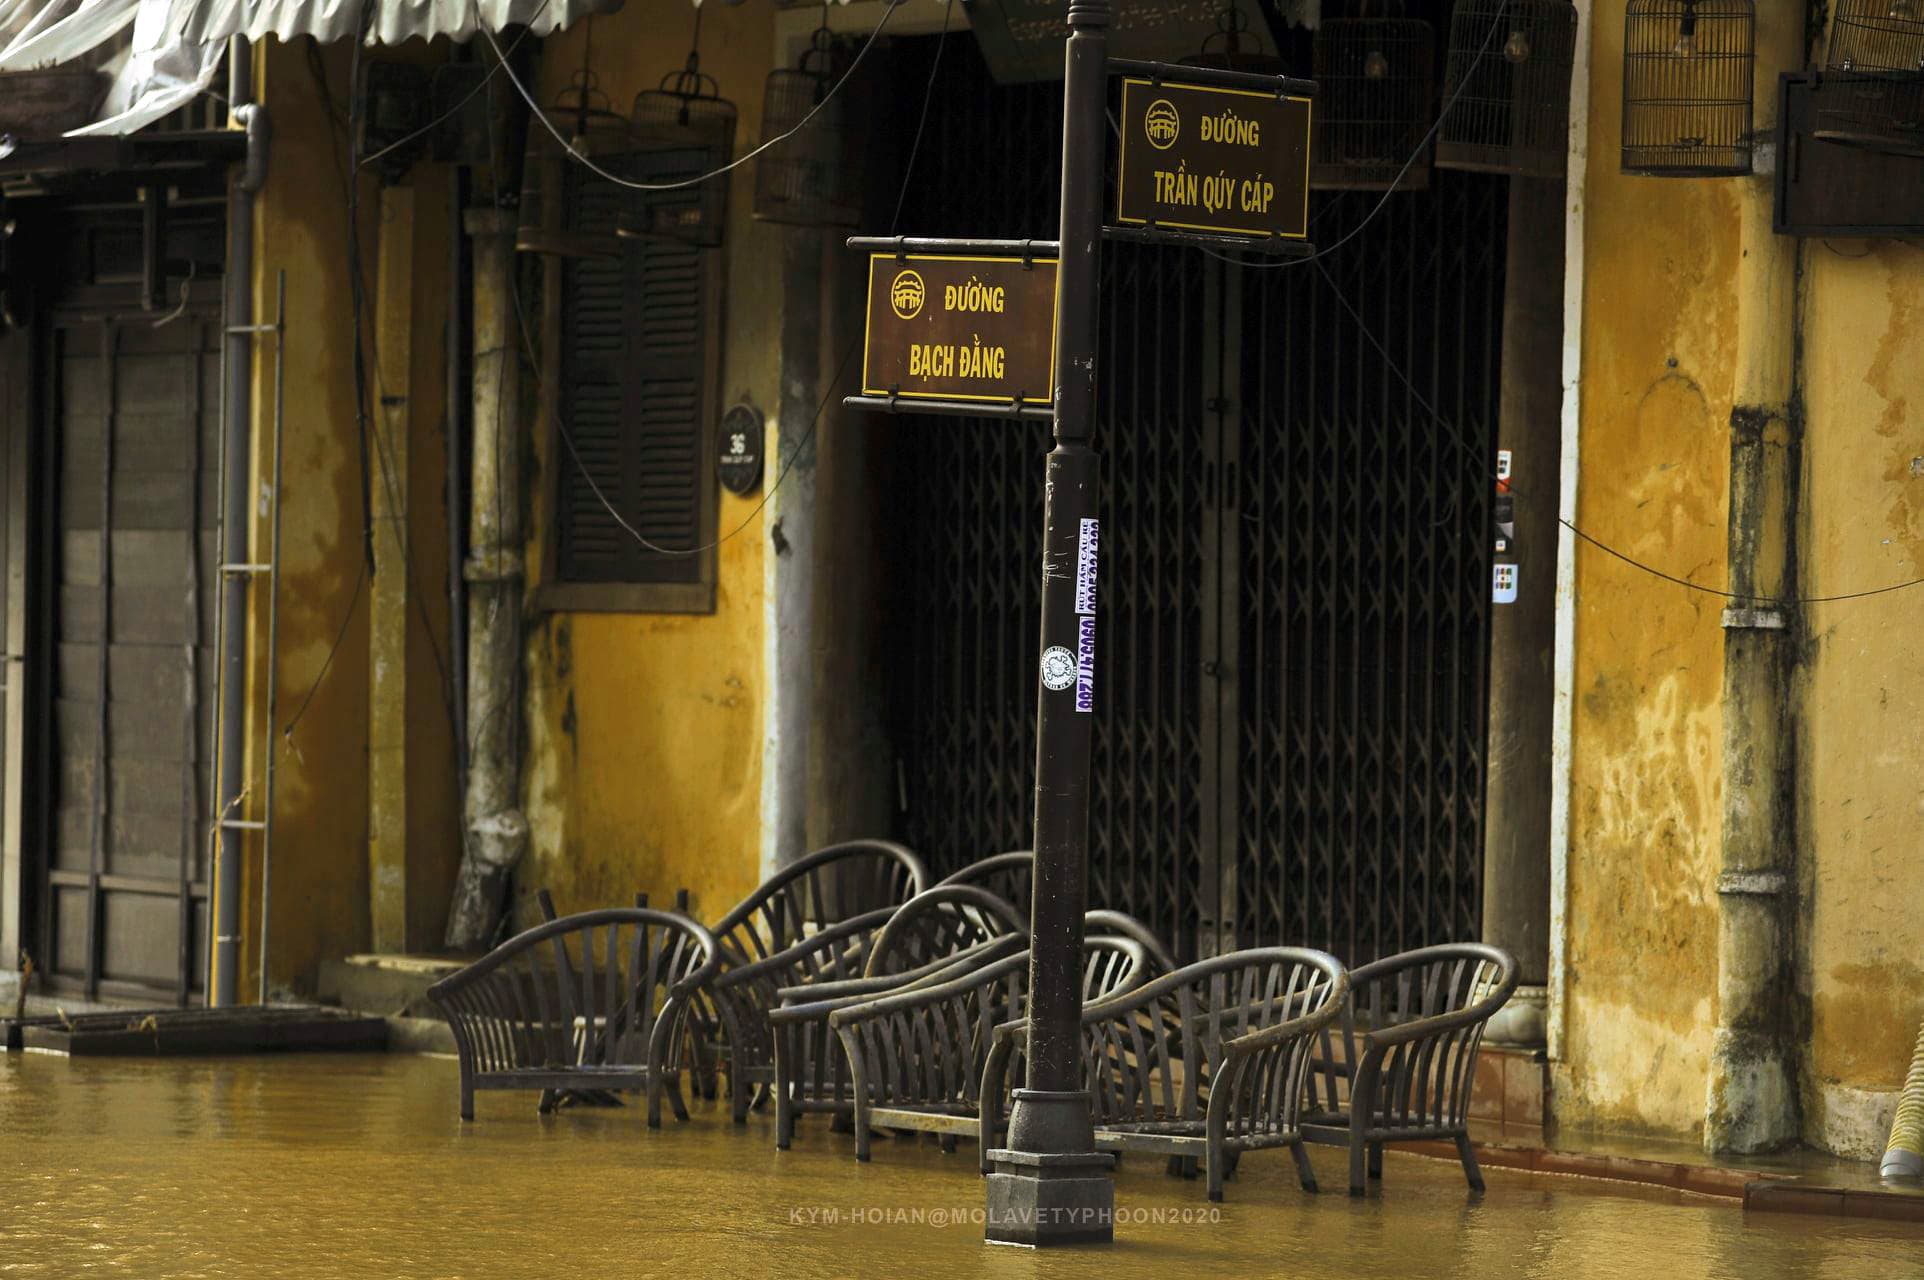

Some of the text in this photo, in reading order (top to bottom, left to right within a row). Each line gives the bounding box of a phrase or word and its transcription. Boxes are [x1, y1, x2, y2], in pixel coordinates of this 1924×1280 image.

[1200, 108, 1260, 147] ĐƯỜNG
[1154, 158, 1198, 207] TRẦN
[1241, 173, 1274, 213] CÁP
[944, 275, 1005, 313] ĐƯỜNG
[909, 333, 1005, 382] BẠCH ĐẰNG
[729, 433, 746, 455] 36
